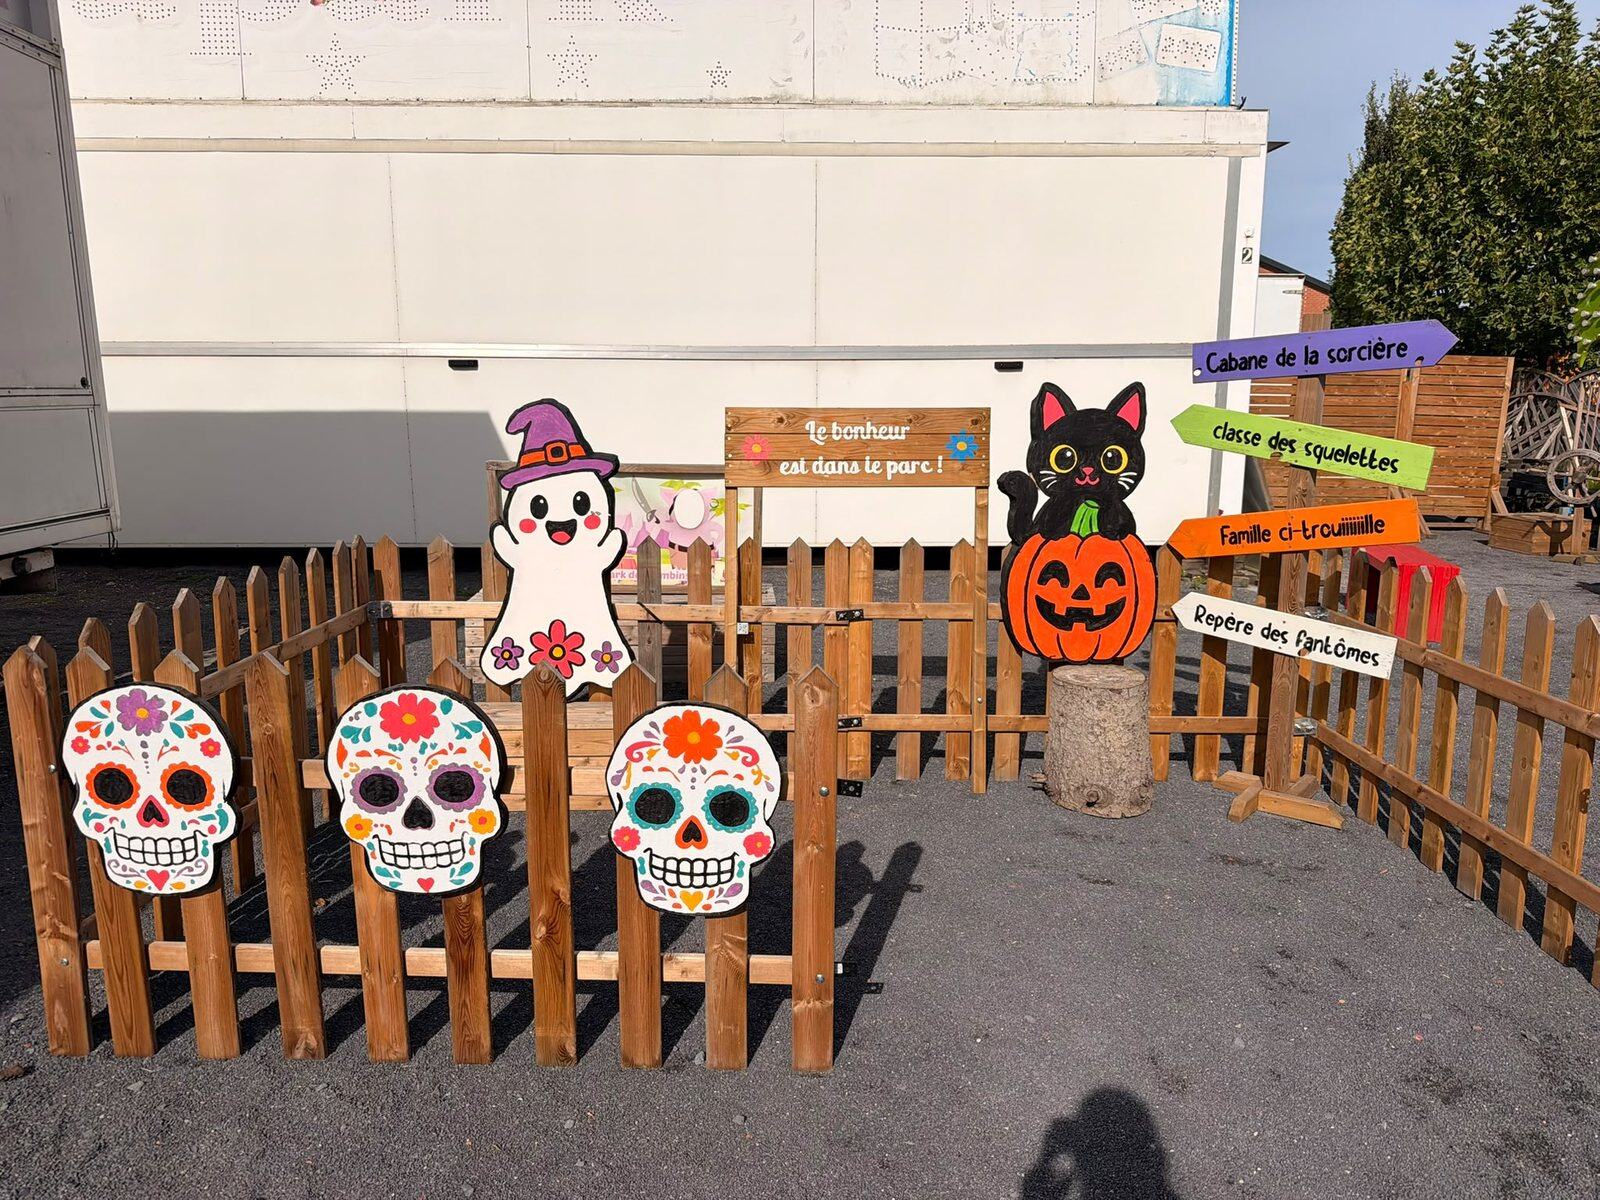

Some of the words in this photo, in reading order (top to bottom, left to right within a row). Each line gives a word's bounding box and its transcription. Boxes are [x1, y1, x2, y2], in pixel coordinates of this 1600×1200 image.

[1240, 246, 1254, 265] 2
[1205, 351, 1268, 374] Cabane
[1275, 346, 1297, 368] de
[1303, 344, 1320, 366] la
[1327, 336, 1409, 364] sorcière
[804, 420, 828, 446] Le
[831, 421, 911, 441] bonheur
[1212, 421, 1262, 447] classe
[1267, 430, 1298, 455] des
[1302, 441, 1402, 476] squelettes
[779, 457, 809, 476] est
[811, 456, 861, 477] dans
[864, 455, 883, 475] le
[886, 460, 933, 481] parc
[1219, 523, 1272, 546] Famille
[1193, 603, 1255, 636] Repère
[1259, 620, 1290, 645] des
[1294, 629, 1381, 668] fantômes
